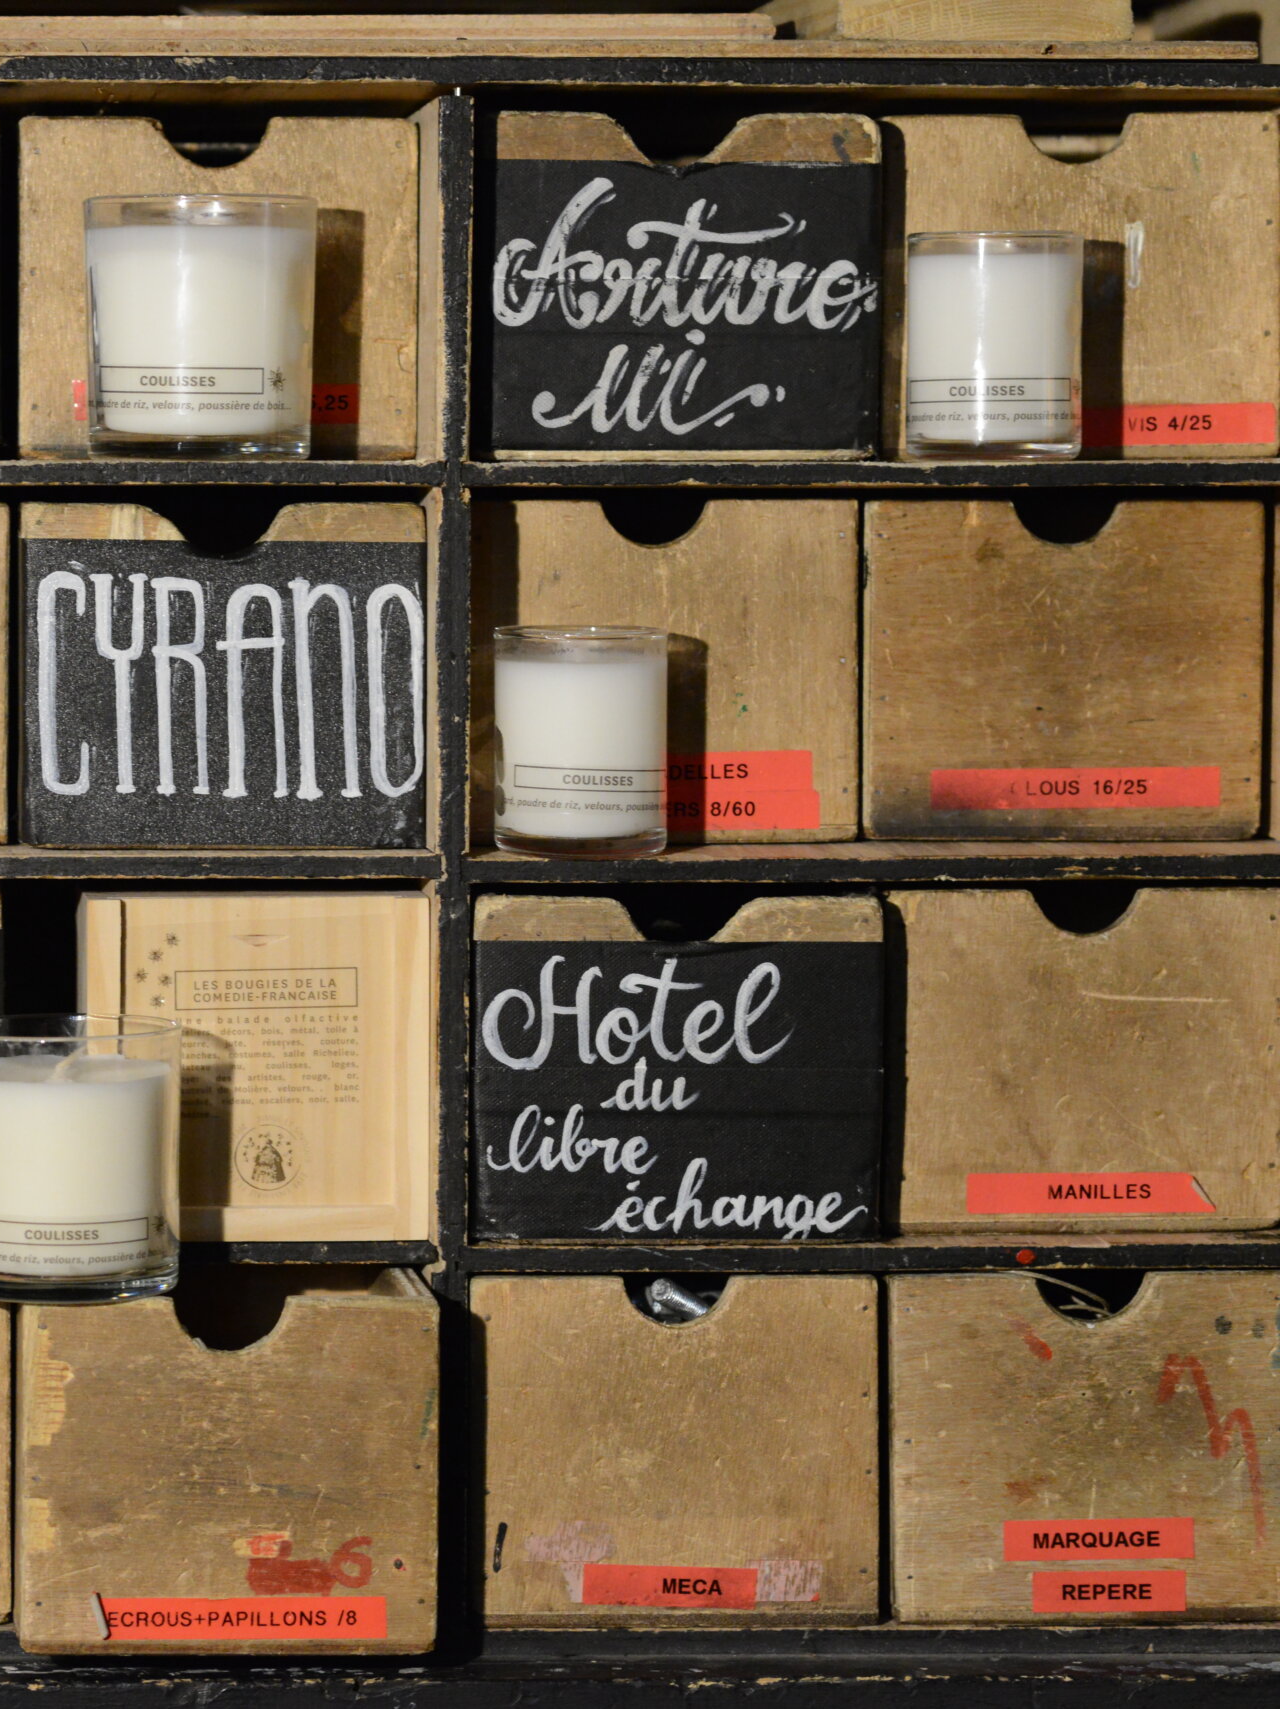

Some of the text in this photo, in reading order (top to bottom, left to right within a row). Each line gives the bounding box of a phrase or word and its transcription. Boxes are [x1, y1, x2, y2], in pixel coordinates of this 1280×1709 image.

[140, 375, 217, 388] COULISSES
[120, 398, 131, 410] de
[133, 399, 149, 412] riz,
[152, 399, 195, 412] velours,
[198, 400, 250, 412] poussière
[253, 399, 265, 411] de
[935, 411, 947, 421] de
[967, 411, 1010, 423] veours,
[1168, 415, 1212, 432] 4/25
[36, 568, 425, 799] CYRANO
[667, 763, 749, 780] DELLES
[562, 774, 633, 787] COULISSES
[1093, 779, 1148, 795] 16/25
[517, 798, 547, 811] poudre
[550, 799, 562, 810] de
[564, 799, 582, 811] riz,
[584, 800, 624, 813] velours,
[710, 801, 756, 817] 8/60
[193, 978, 337, 991] LES BOUGIES DE LA
[193, 990, 337, 1003] COMEDIE-FRANCAISE
[217, 1015, 270, 1025] balade
[284, 1014, 359, 1024] olfactive
[482, 955, 797, 1070] Hotel
[600, 1056, 701, 1112] du
[487, 1104, 659, 1175] libre
[1047, 1183, 1152, 1201] MANILLES
[24, 1229, 100, 1241] COULISSES
[9, 1252, 21, 1264] de
[23, 1254, 41, 1265] riz,
[43, 1254, 85, 1265] velours,
[87, 1251, 134, 1265] poussière
[1033, 1531, 1161, 1549] MARQUAGE
[661, 1576, 723, 1597] MECA
[1061, 1581, 1153, 1602] REPERE
[338, 1610, 357, 1627] /8
